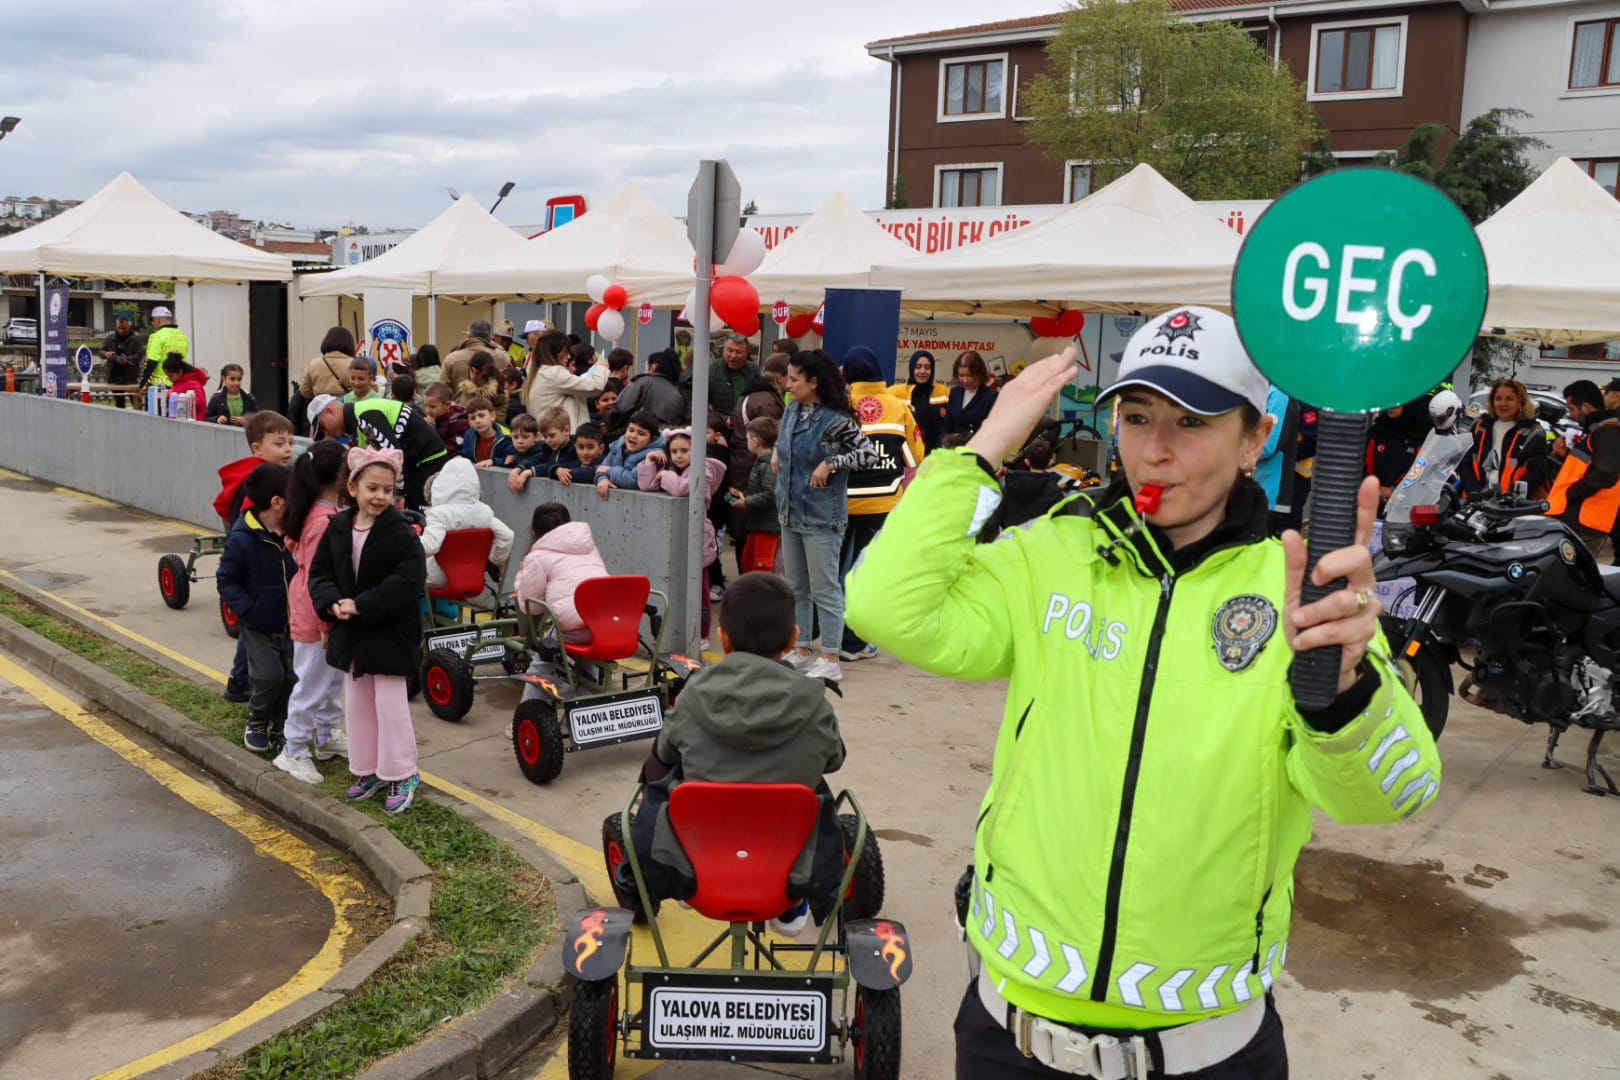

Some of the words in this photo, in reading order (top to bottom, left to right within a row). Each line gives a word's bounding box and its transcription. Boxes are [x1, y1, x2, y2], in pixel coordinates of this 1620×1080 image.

[1281, 241, 1437, 341] GEÇ
[638, 308, 653, 319] DUR
[772, 306, 789, 317] DUR
[910, 328, 938, 337] MAYIS
[898, 339, 910, 349] LK
[912, 340, 951, 350] YARDIM
[952, 341, 996, 351] HAFTASI
[1139, 344, 1200, 361] POLİS
[576, 710, 608, 726] YALOVA
[609, 701, 656, 719] BELEDİYESİ
[578, 727, 603, 738] ULAŞIM
[618, 714, 658, 730] MÜDÜRLÜĞÜ
[661, 999, 721, 1019] YALOVA
[725, 998, 815, 1022] BELEDİYESİ
[660, 1023, 706, 1041] ULAŞIM
[710, 1022, 734, 1039] HİZ.
[738, 1023, 815, 1041] MÜDÜRLÜĞÜ
